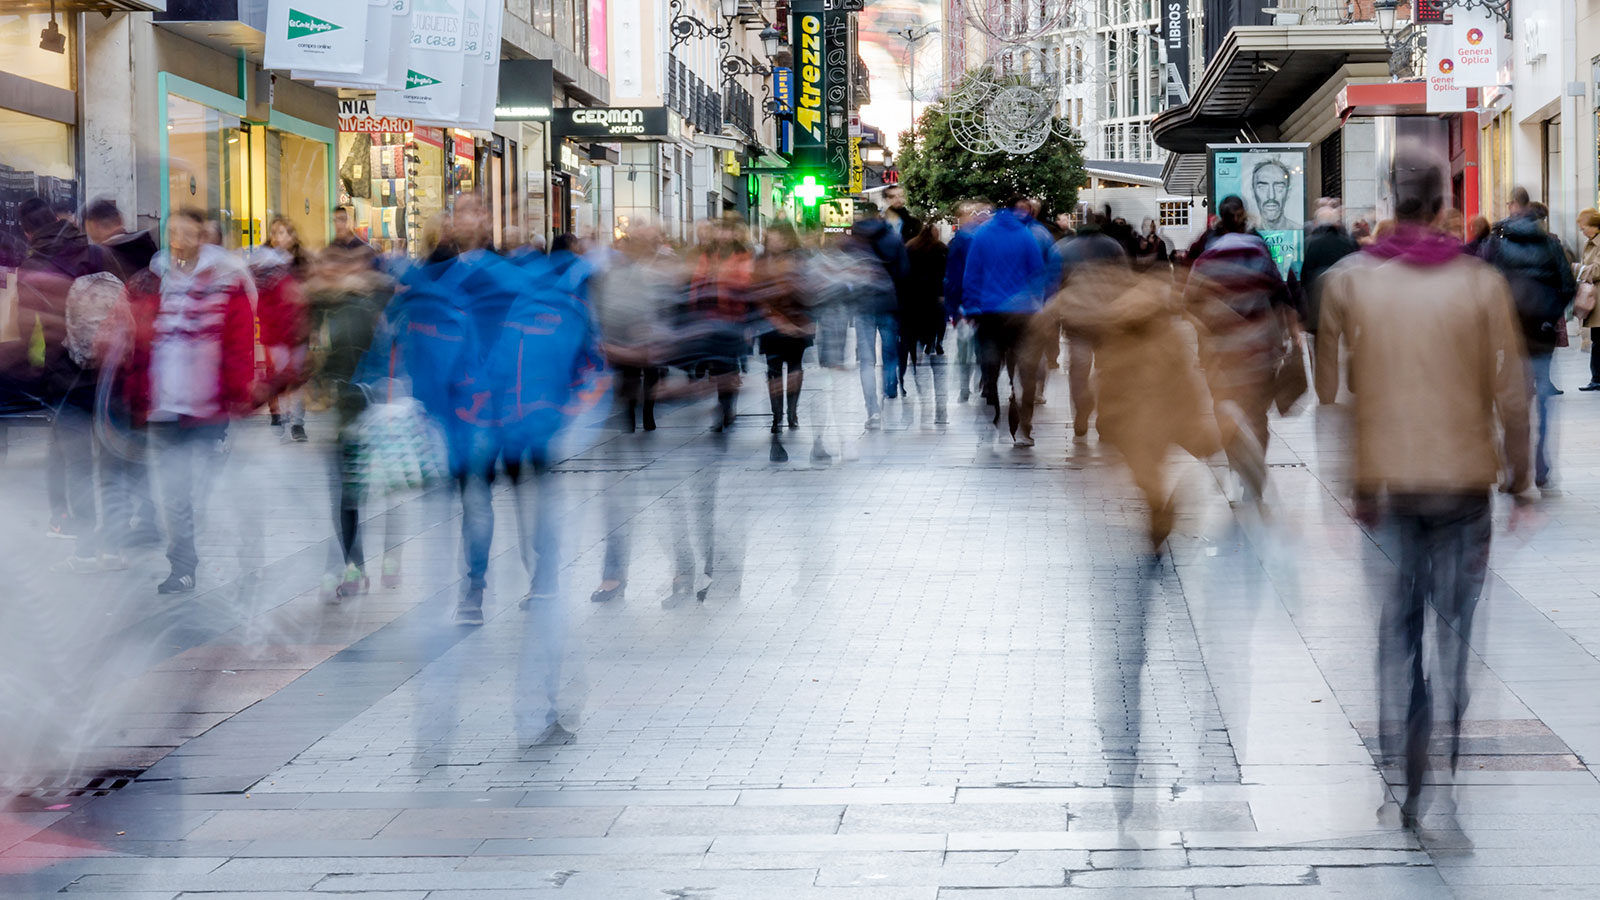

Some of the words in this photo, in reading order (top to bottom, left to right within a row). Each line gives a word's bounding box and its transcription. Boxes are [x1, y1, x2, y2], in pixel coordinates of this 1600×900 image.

[412, 14, 459, 33] JUGUETES
[1169, 3, 1182, 49] LIBROS
[426, 35, 456, 47] casa
[1458, 47, 1492, 56] General
[1461, 56, 1489, 66] Optica
[1430, 76, 1455, 84] Gener
[572, 109, 644, 127] GERMAN
[339, 119, 411, 132] NIVERSARIO
[609, 125, 645, 134] JOYERO
